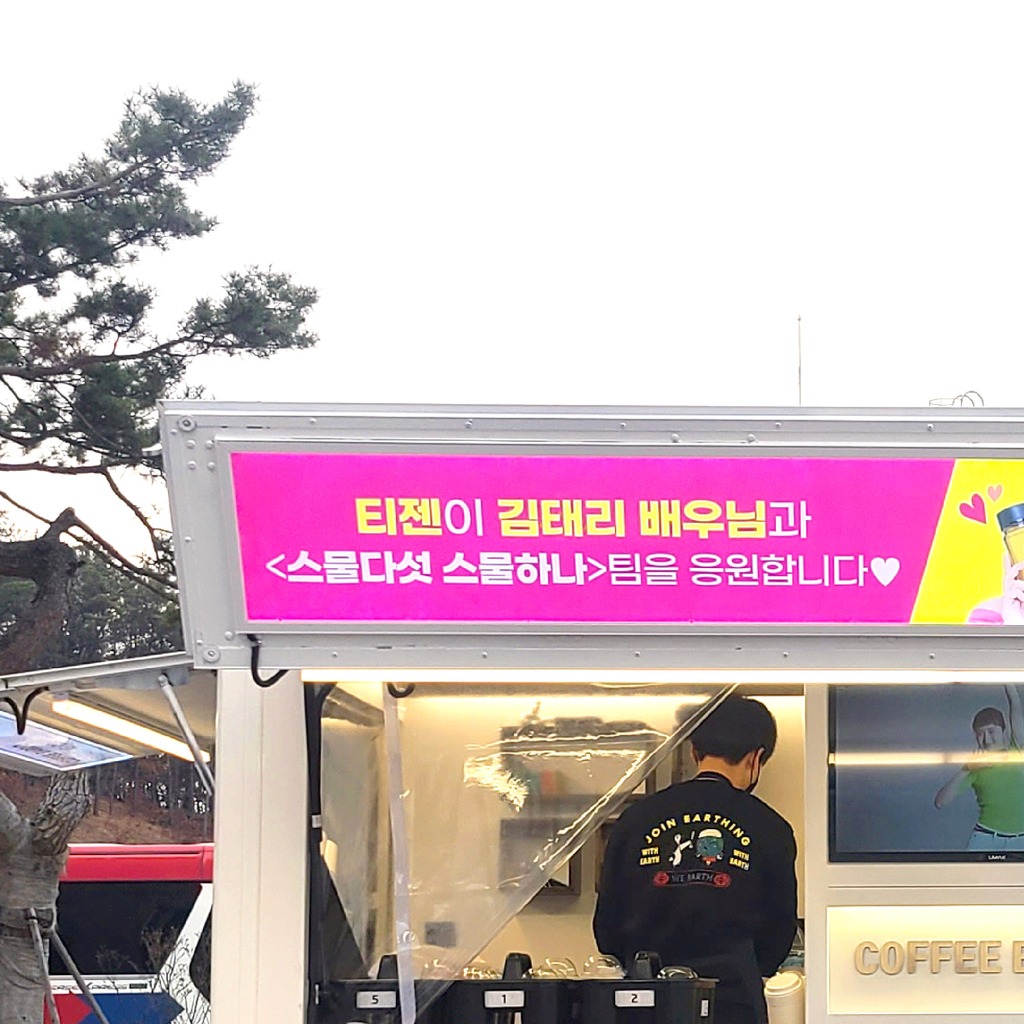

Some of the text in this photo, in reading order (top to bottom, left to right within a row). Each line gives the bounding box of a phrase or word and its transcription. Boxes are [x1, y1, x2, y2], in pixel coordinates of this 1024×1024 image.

[355, 498, 812, 539] 티젠이 김태리 배우님과
[265, 550, 433, 586] <스물다섯
[443, 551, 679, 587] 스물하나>팀을
[645, 813, 751, 846] JOIN EARTHING
[641, 847, 659, 856] WITH
[733, 849, 750, 861] WITH
[729, 858, 750, 871] EARTH
[854, 939, 1002, 976] COFFEE
[371, 994, 379, 1004] 5
[501, 994, 507, 1004] 1
[631, 994, 639, 1004] 2
